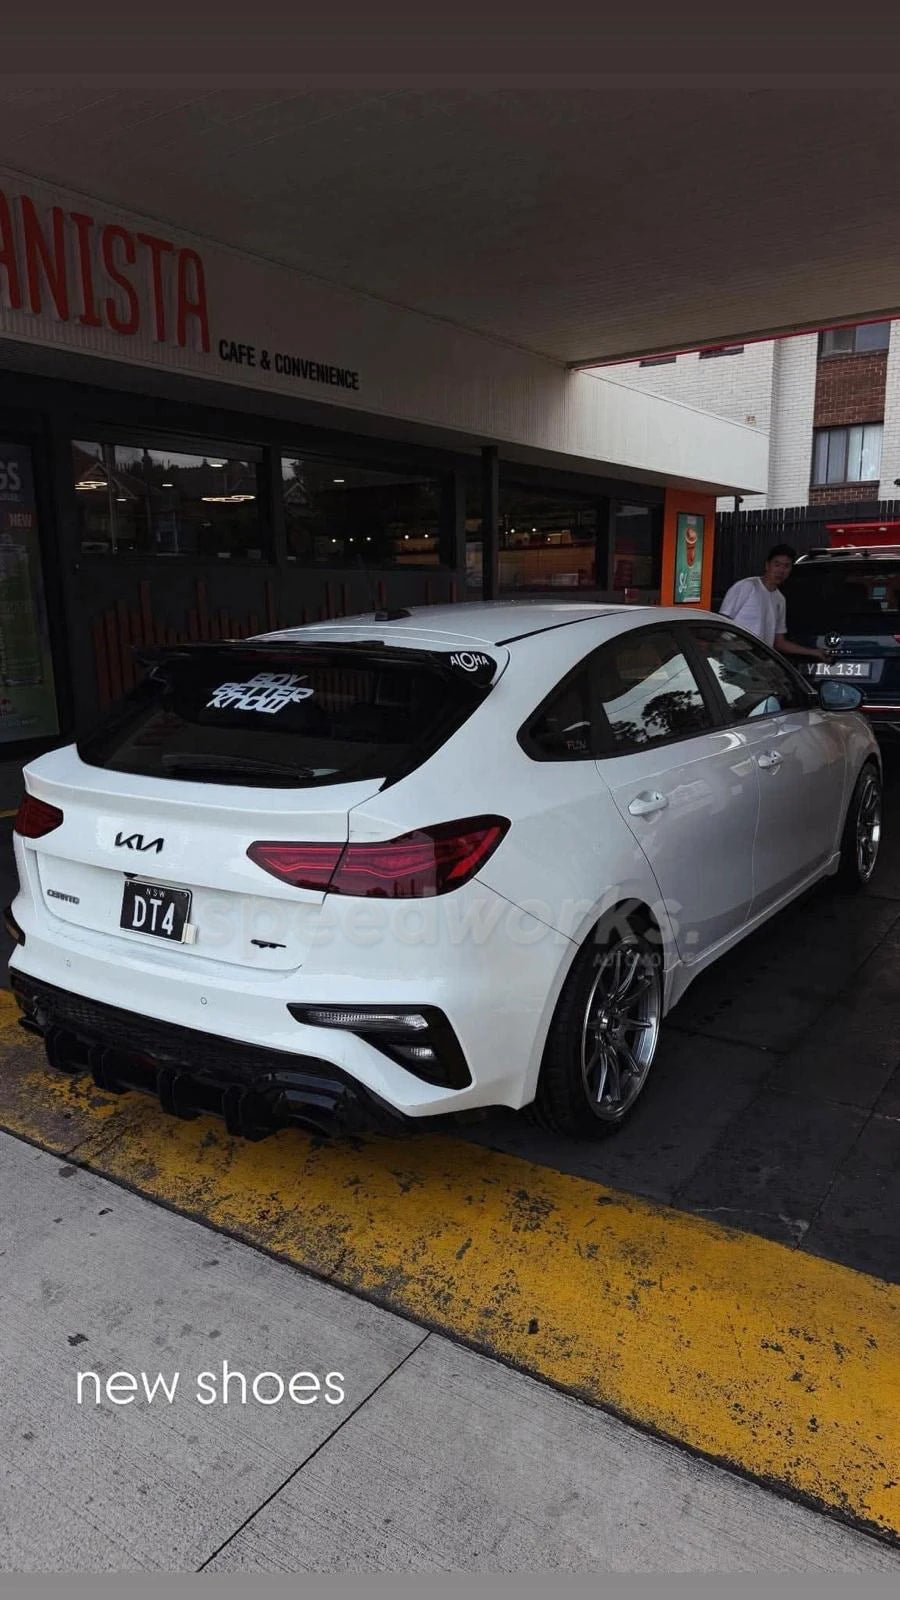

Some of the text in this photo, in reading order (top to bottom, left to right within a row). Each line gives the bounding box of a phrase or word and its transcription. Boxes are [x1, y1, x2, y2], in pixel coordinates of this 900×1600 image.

[219, 340, 359, 390] CAFE & CONVENIENCE
[9, 513, 32, 528] NEW
[450, 652, 490, 672] ALOHA
[836, 663, 862, 676] 131
[247, 672, 309, 686] BOY
[212, 682, 314, 703] BETTER
[115, 832, 164, 854] KIA
[145, 888, 166, 898] NSW
[132, 895, 175, 935] DT4
